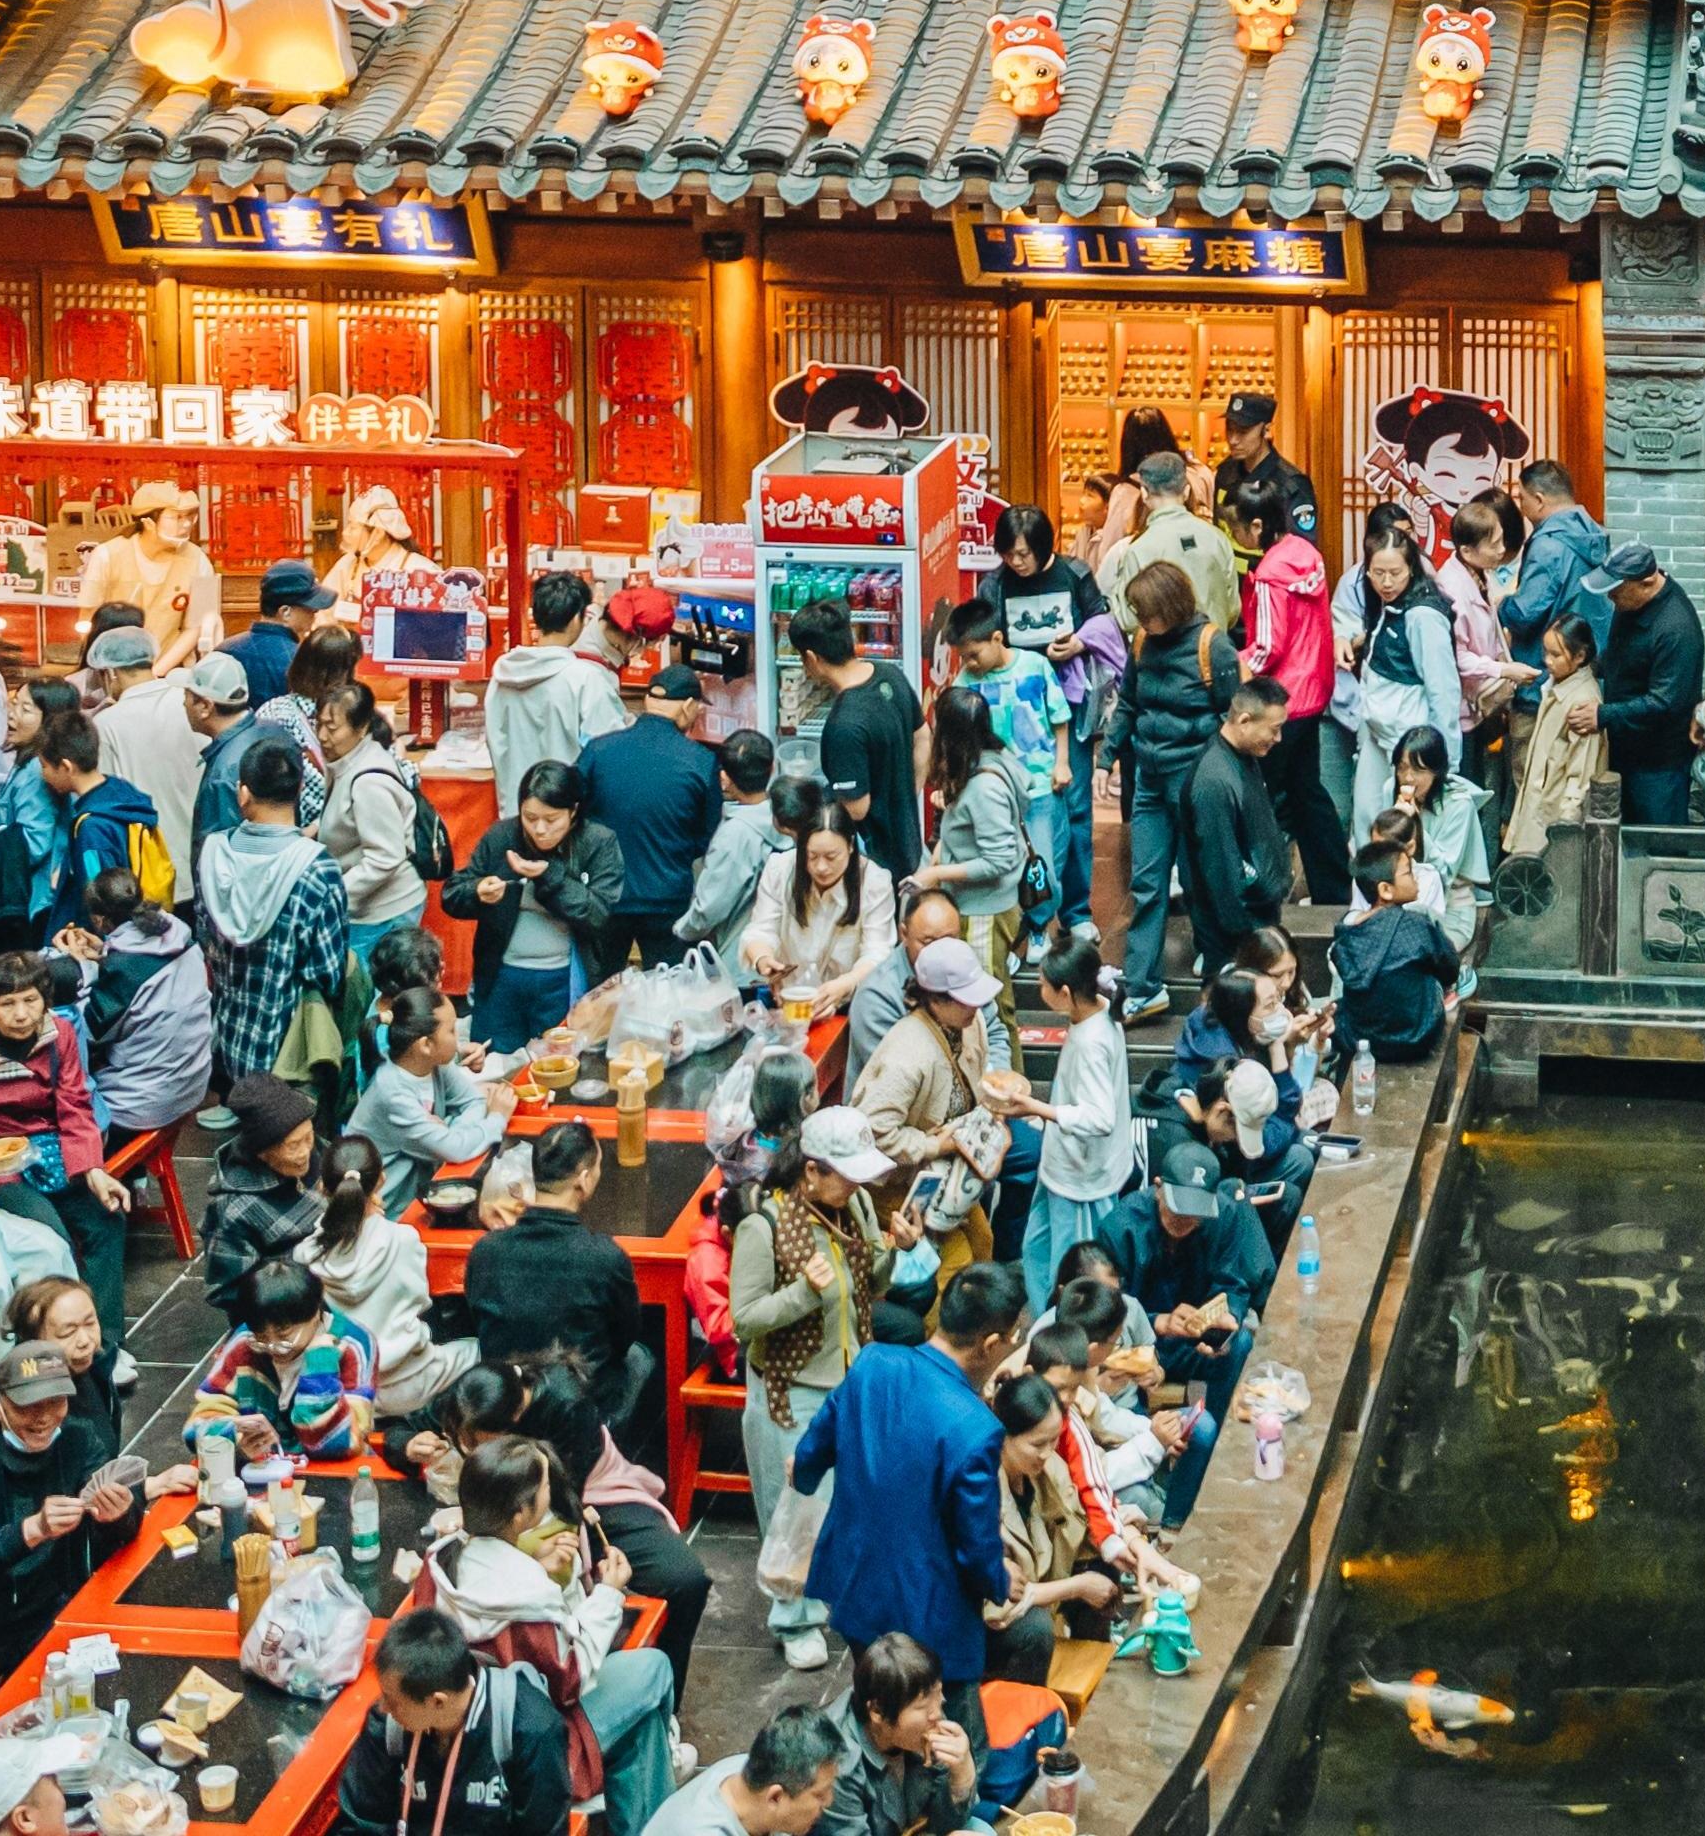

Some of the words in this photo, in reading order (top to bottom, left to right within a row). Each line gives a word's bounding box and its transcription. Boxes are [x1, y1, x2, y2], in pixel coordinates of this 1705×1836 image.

[147, 197, 455, 253] 唐山宴有礼
[1011, 230, 1326, 277] 唐山宴麻糖
[303, 402, 426, 446] 伴手礼
